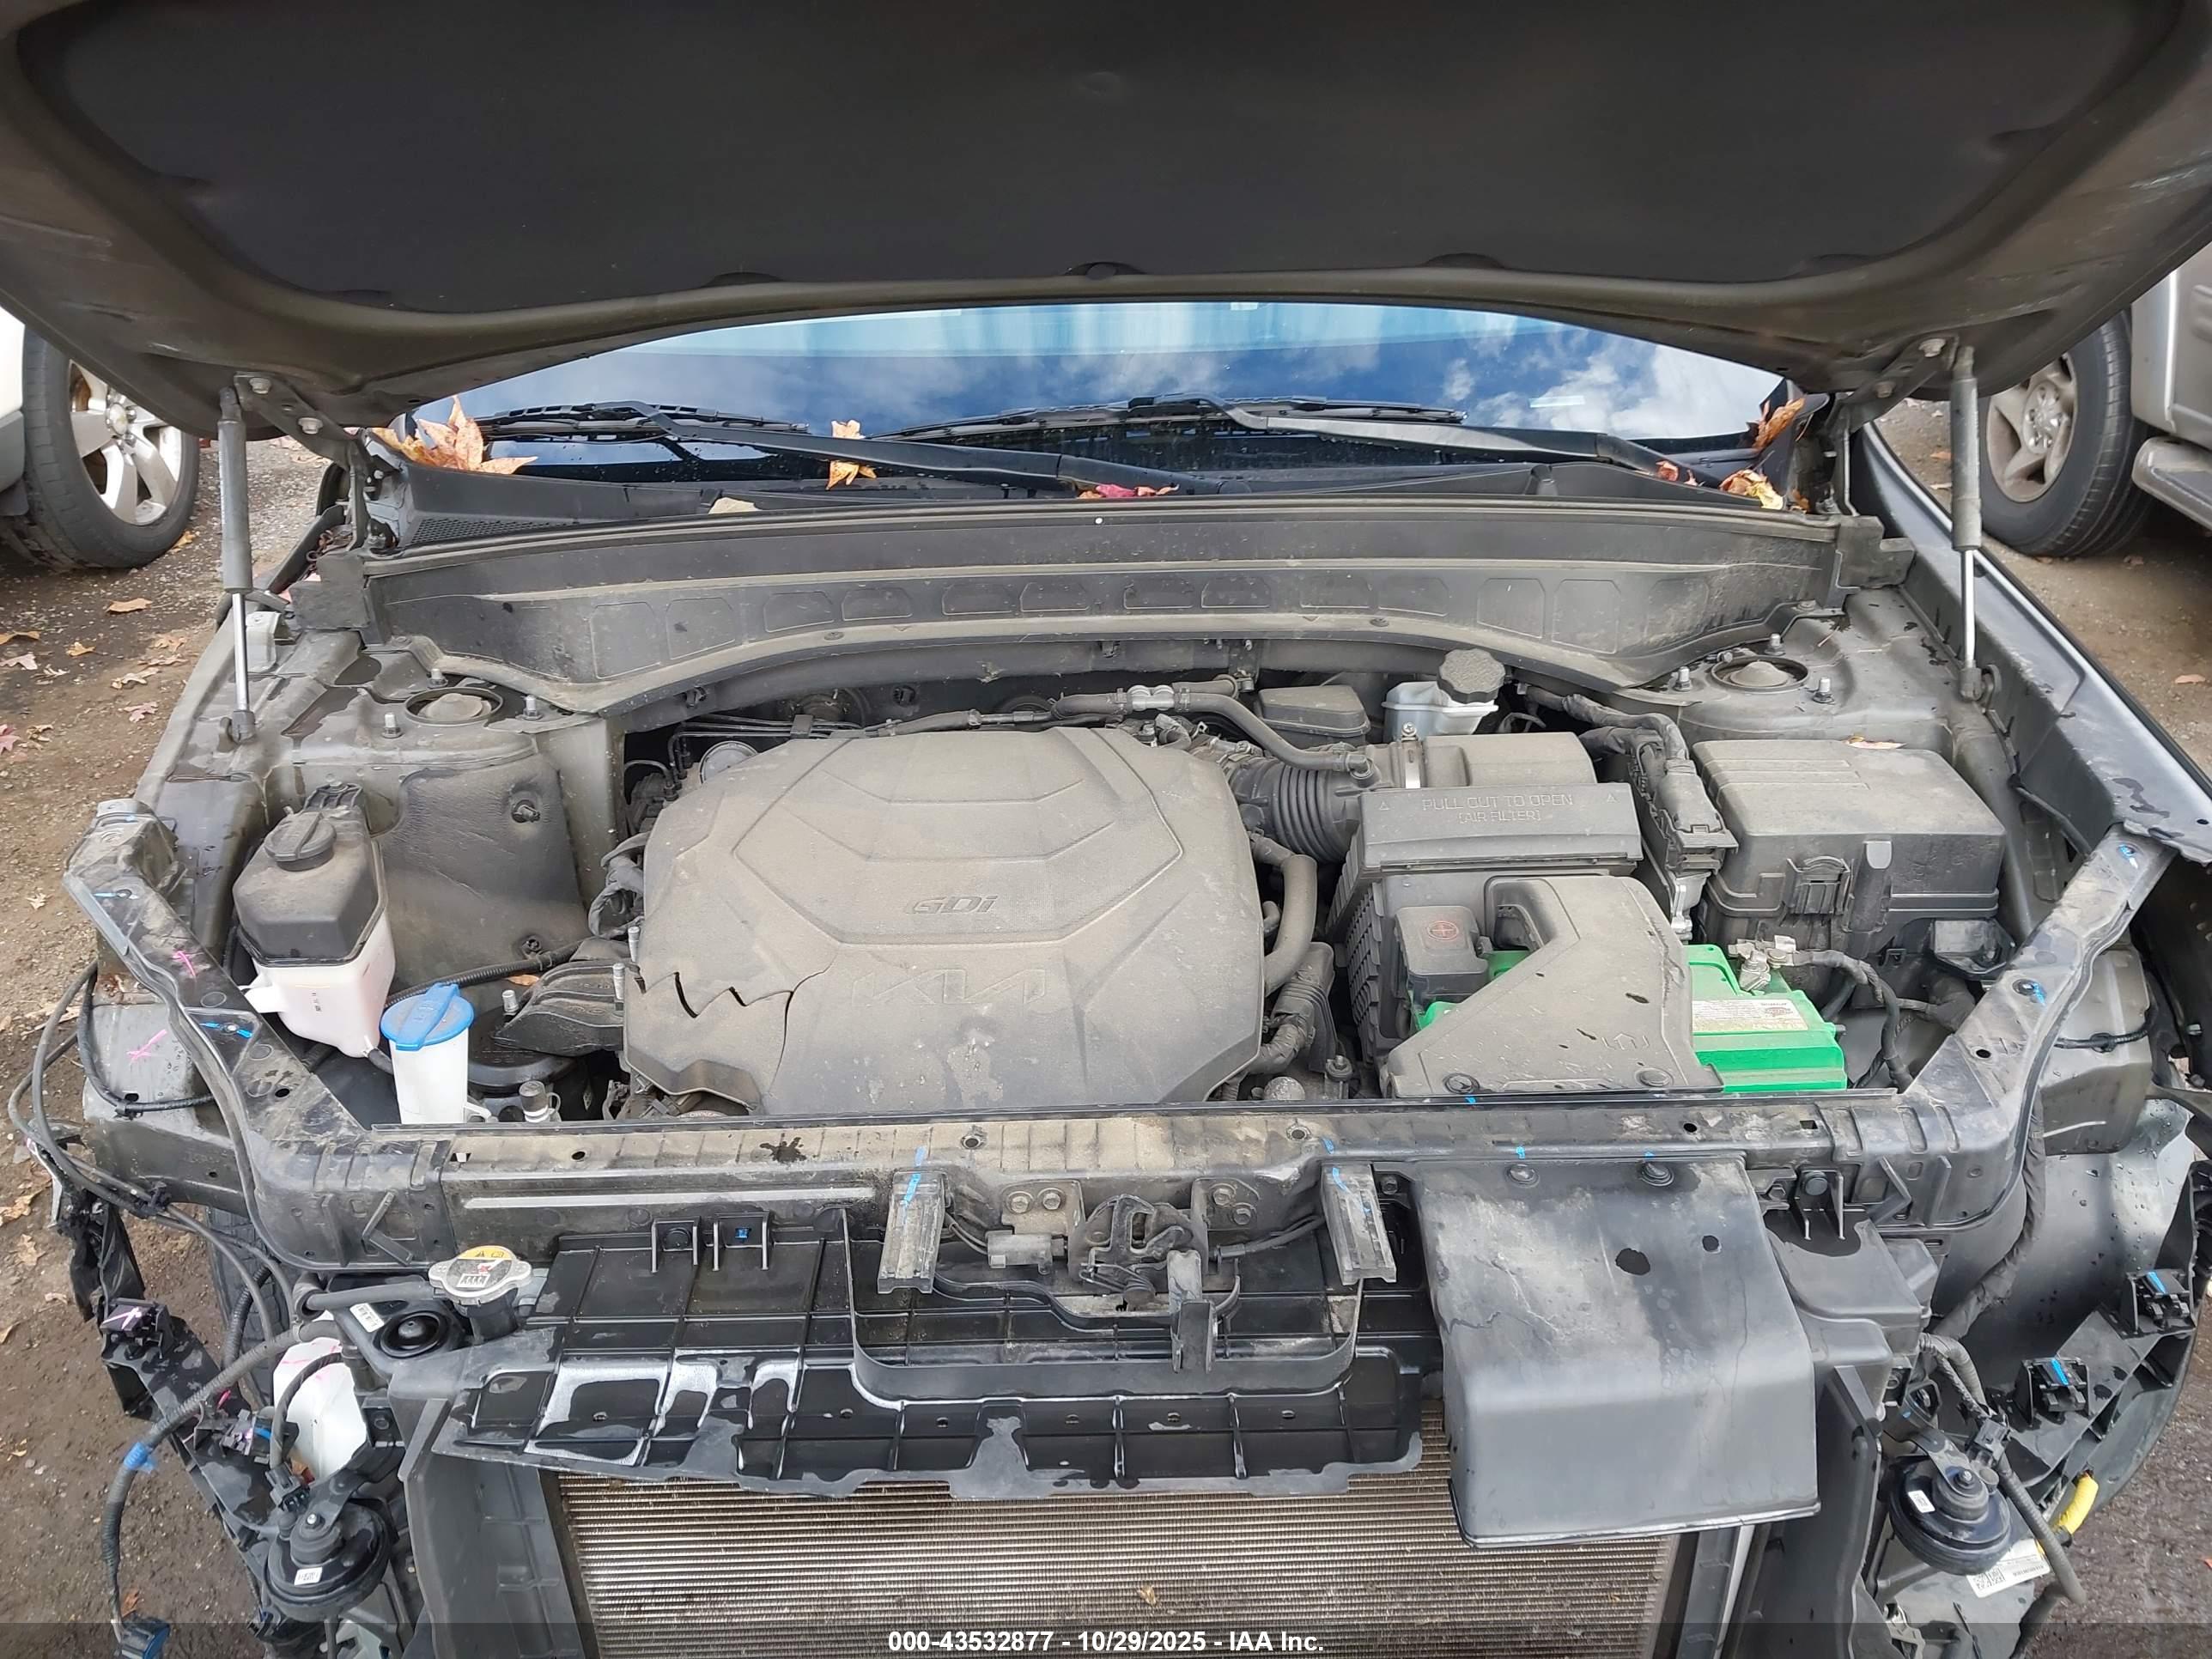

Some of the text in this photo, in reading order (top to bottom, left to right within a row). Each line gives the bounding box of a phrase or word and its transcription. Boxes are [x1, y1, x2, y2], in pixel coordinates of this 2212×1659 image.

[1421, 793, 1574, 811] PULL OUT TO OPEN
